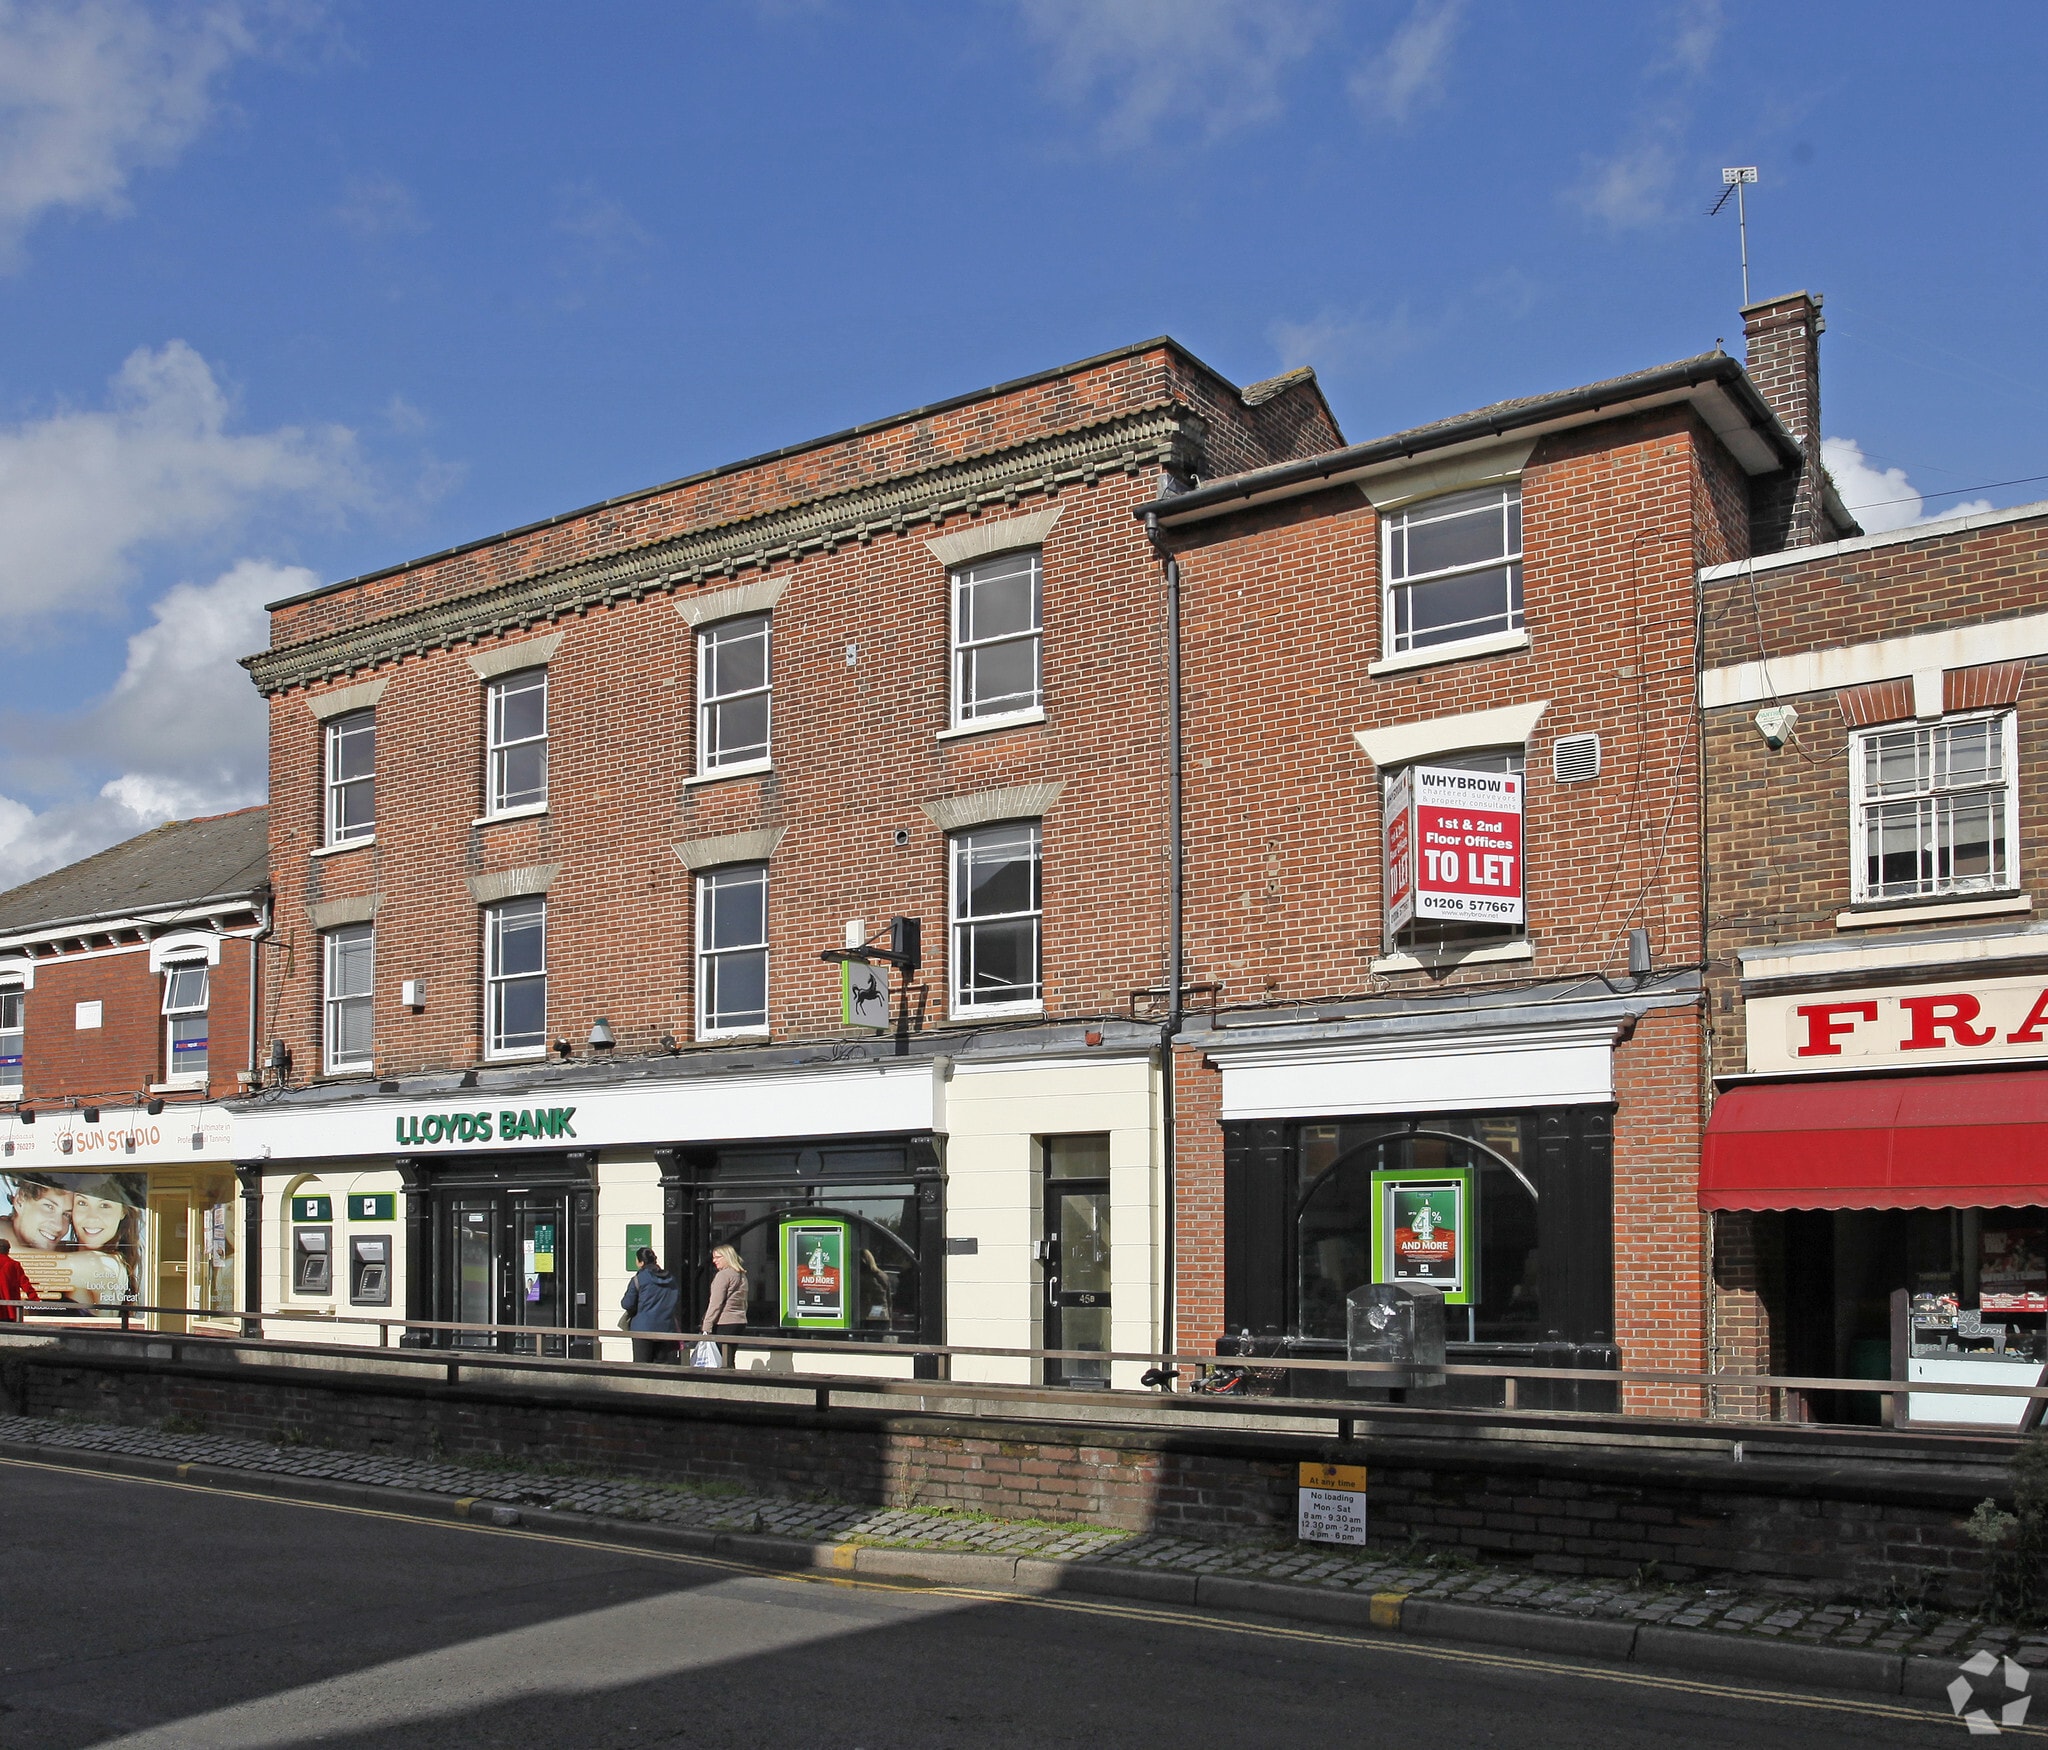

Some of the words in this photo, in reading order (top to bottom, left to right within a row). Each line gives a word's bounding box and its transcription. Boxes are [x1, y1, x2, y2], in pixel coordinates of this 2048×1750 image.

[1422, 774, 1501, 792] WHYBROW
[1422, 788, 1467, 798] chartered
[1472, 792, 1516, 802] surveyors
[1432, 797, 1467, 807] property
[1470, 800, 1516, 810] consultants
[1438, 817, 1458, 830] 1st
[1462, 819, 1473, 830] &
[1477, 821, 1502, 833] 2nd
[1426, 832, 1461, 845] Floor
[1464, 835, 1513, 850] Offices
[1424, 849, 1459, 882] TO
[1468, 853, 1514, 887] LET
[1424, 897, 1463, 910] 01206
[1469, 900, 1515, 913] 577667
[1442, 910, 1499, 919] www.whybrow.net
[396, 1112, 493, 1145] LLOYDS
[500, 1107, 576, 1141] BANK
[77, 1130, 104, 1152] SUN
[108, 1126, 160, 1151] STUDIO
[1401, 1242, 1420, 1250] AND
[1422, 1242, 1448, 1250] MORE
[801, 1276, 814, 1284] AND
[816, 1276, 834, 1285] MORE
[100, 1292, 116, 1302] Feel
[1310, 1477, 1319, 1485] At
[1321, 1478, 1335, 1487] any
[1338, 1480, 1356, 1488] time
[1311, 1491, 1322, 1499] No
[1325, 1492, 1354, 1503] loading
[1313, 1503, 1331, 1511] Mon
[1337, 1505, 1351, 1513] Sat
[1304, 1511, 1309, 1519] 8
[1328, 1514, 1348, 1523] 9.30
[1302, 1520, 1324, 1529] 12.30
[1316, 1531, 1329, 1539] pm
